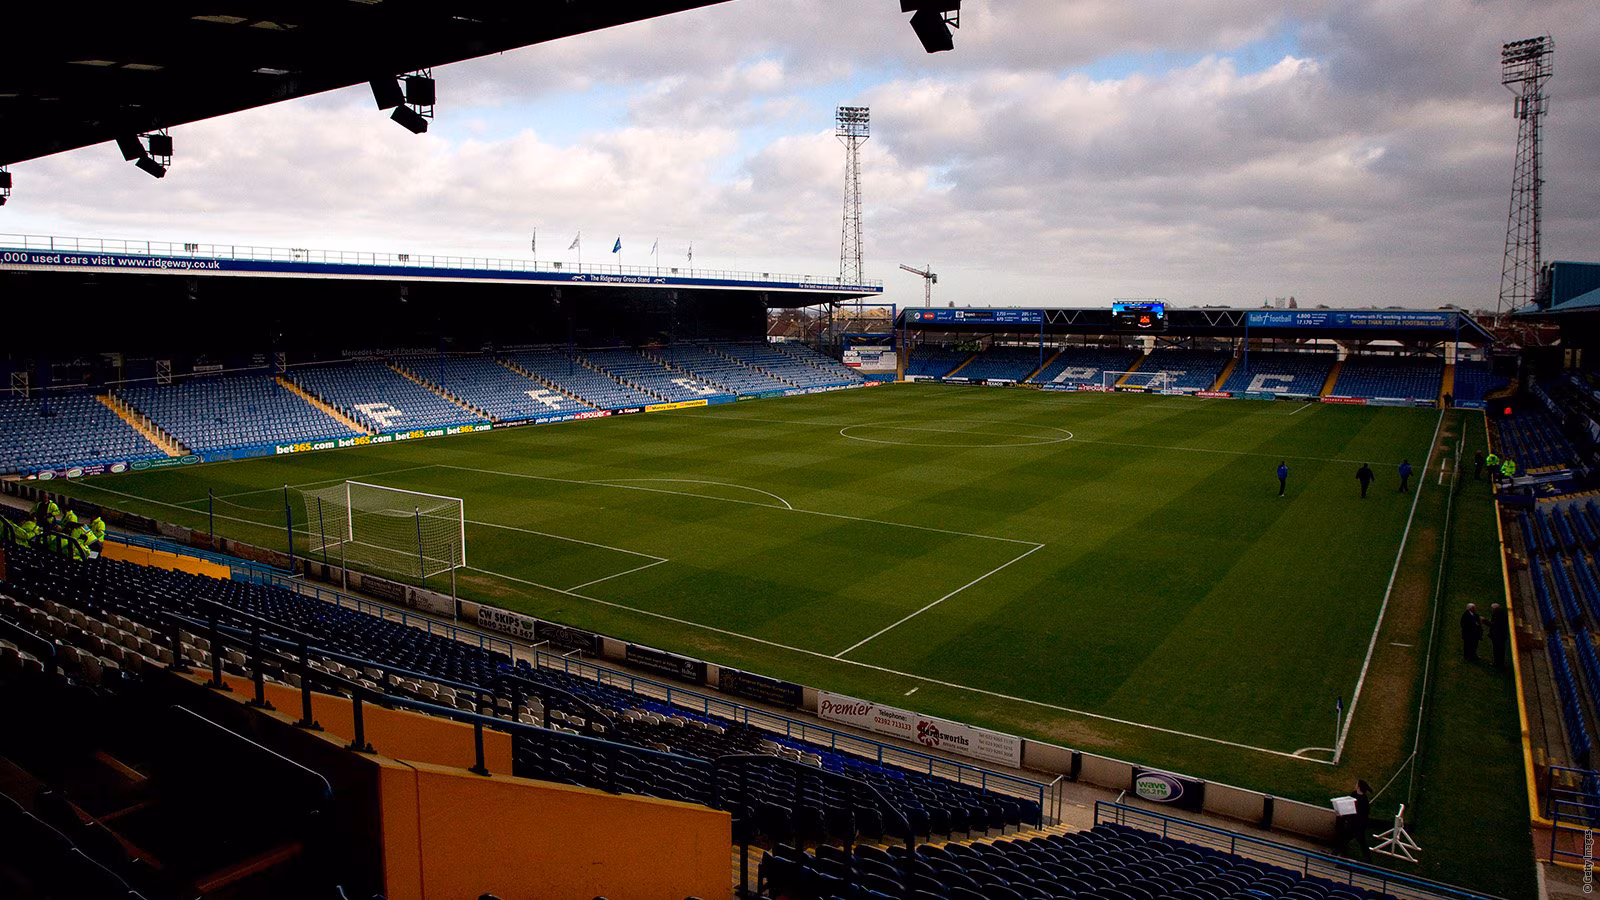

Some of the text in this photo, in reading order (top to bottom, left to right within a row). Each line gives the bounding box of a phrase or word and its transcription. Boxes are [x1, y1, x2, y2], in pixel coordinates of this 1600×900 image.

[32, 254, 60, 264] used
[64, 256, 89, 265] cars
[91, 255, 115, 266] visit
[118, 257, 220, 271] www.ridgeway.co.uk
[600, 275, 622, 284] Ridgeway
[395, 430, 445, 441] bet365.com
[446, 424, 491, 435] bet365.com
[338, 435, 393, 447] bet365.com
[276, 442, 335, 455] bet365.com
[479, 608, 520, 628] CW SKIPS
[479, 618, 497, 629] 0800
[498, 624, 512, 633] 234
[519, 629, 534, 639] 567
[820, 699, 873, 717] Premier
[878, 709, 908, 723] Telephone:
[874, 716, 891, 727] 02392
[891, 720, 912, 732] 713133
[1138, 781, 1166, 790] wave
